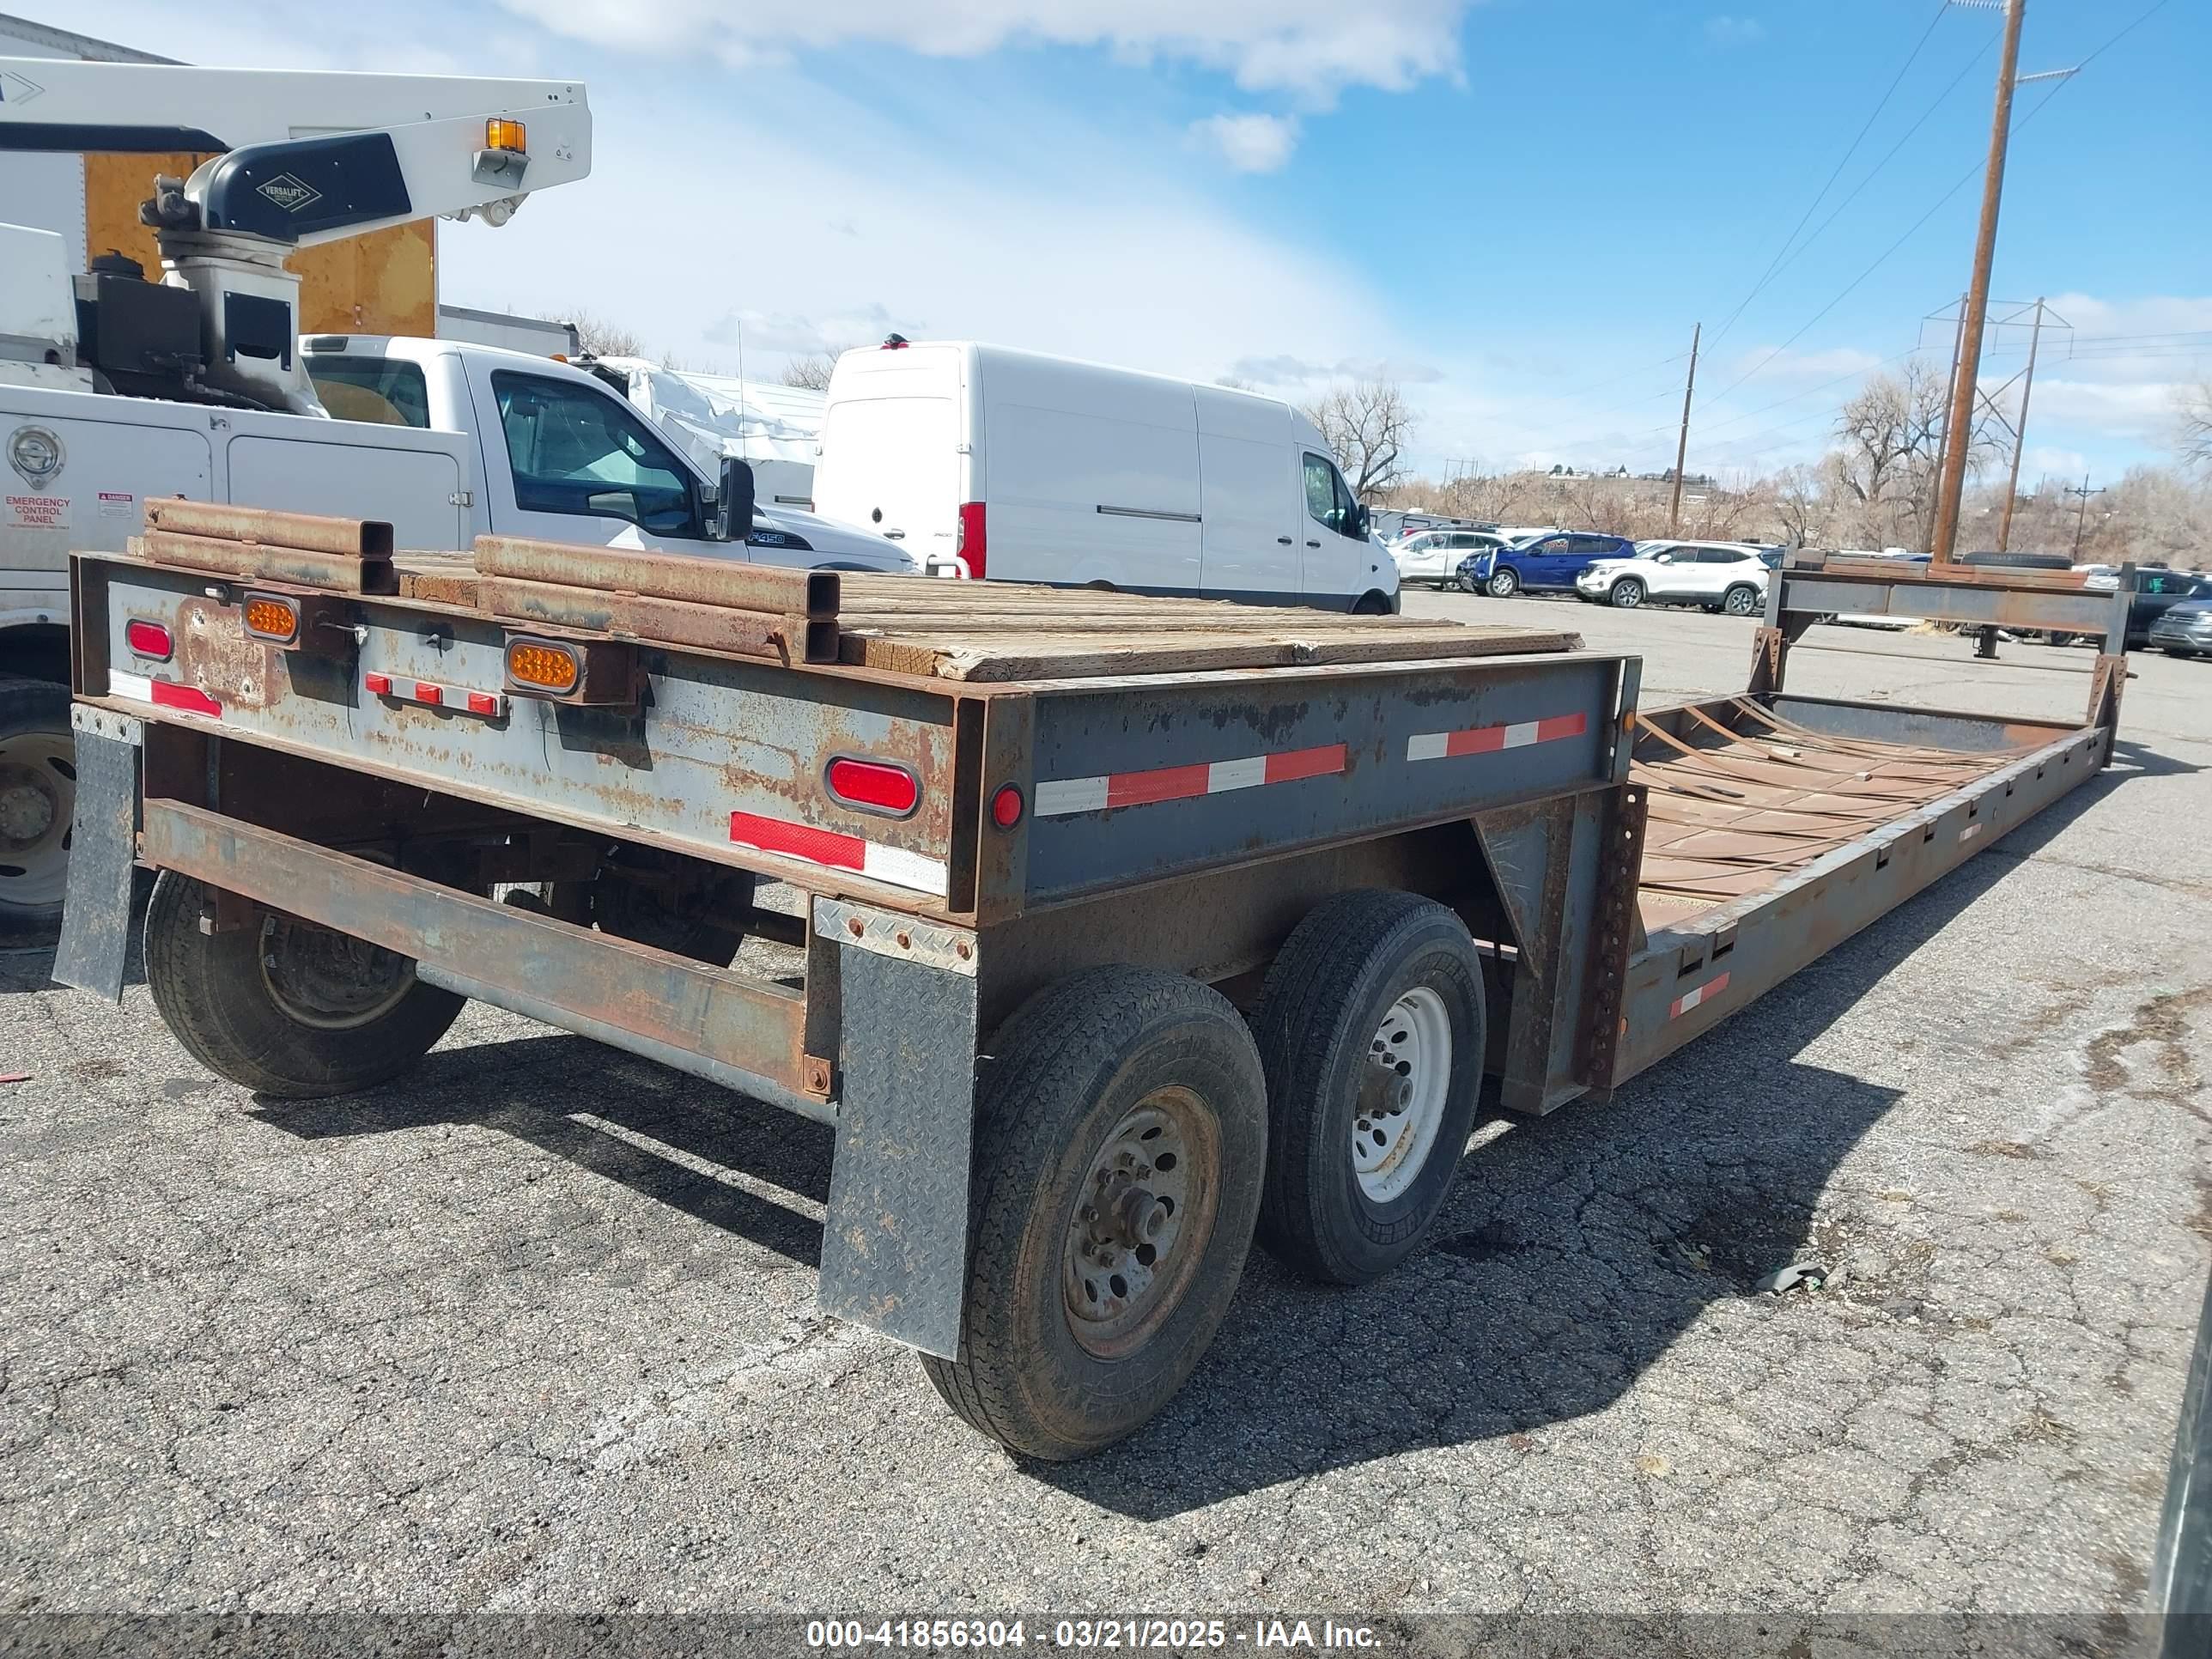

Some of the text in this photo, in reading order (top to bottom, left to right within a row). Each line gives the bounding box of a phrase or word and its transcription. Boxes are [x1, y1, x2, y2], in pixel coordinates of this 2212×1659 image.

[264, 185, 301, 197] VERSALIFT
[6, 496, 70, 507] EMERGENCY
[15, 506, 62, 515] CONTROL
[749, 532, 785, 544] F-450
